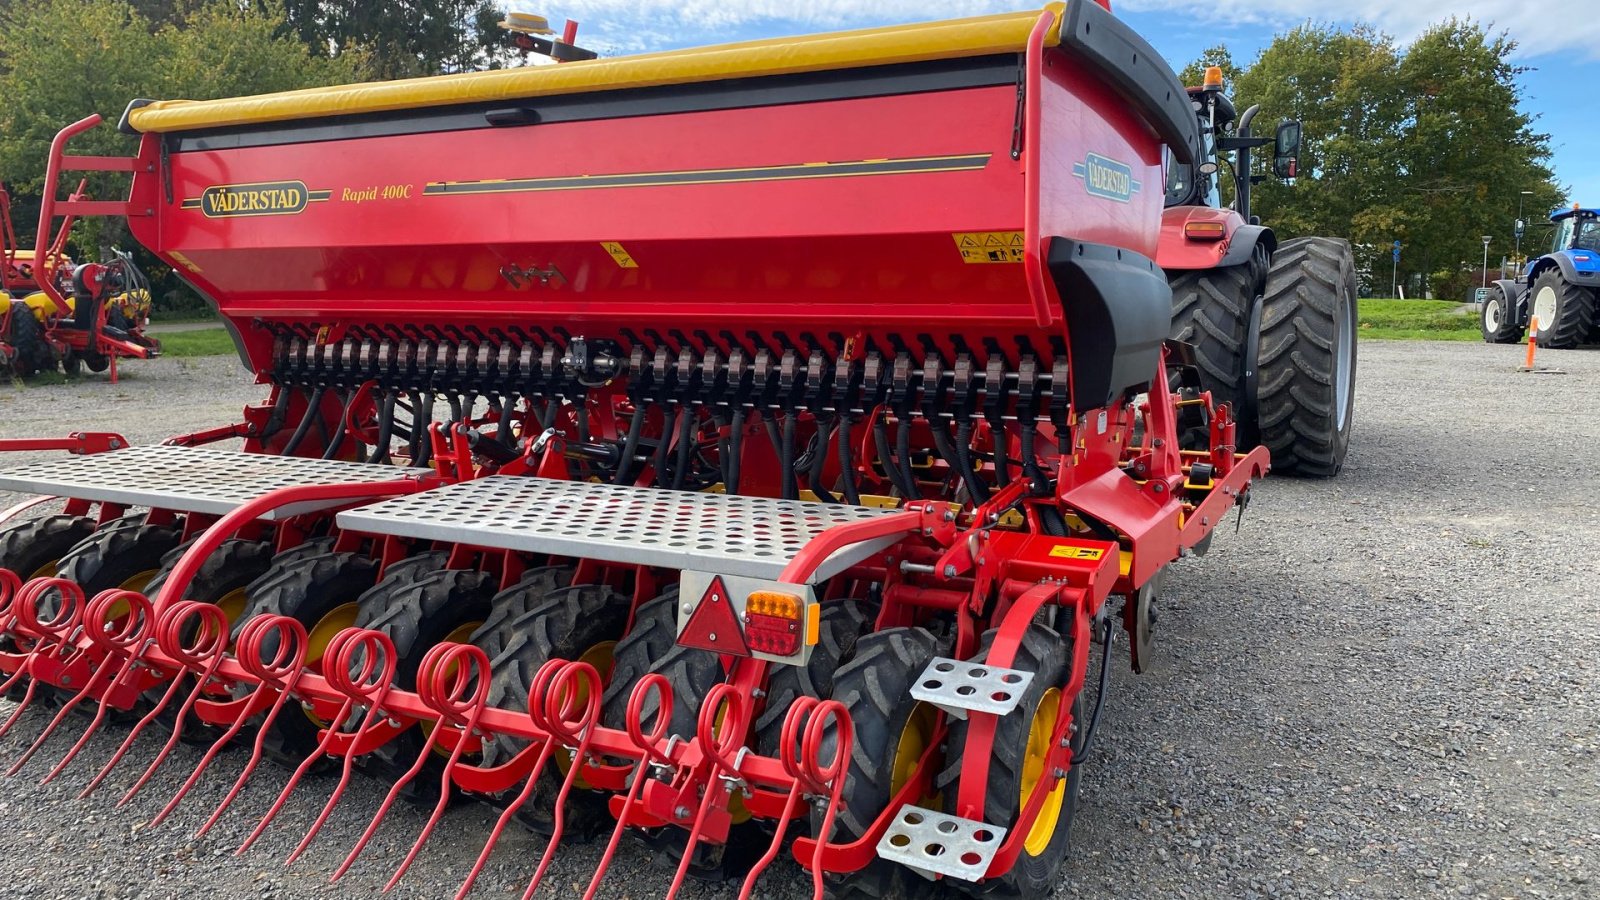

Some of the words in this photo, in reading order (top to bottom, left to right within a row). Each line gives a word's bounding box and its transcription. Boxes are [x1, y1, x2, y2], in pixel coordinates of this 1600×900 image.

[1088, 158, 1129, 195] VÄDERSTAD
[208, 188, 300, 212] VÄDERSTAD
[341, 186, 377, 204] Rapid
[381, 184, 413, 200] 400C
